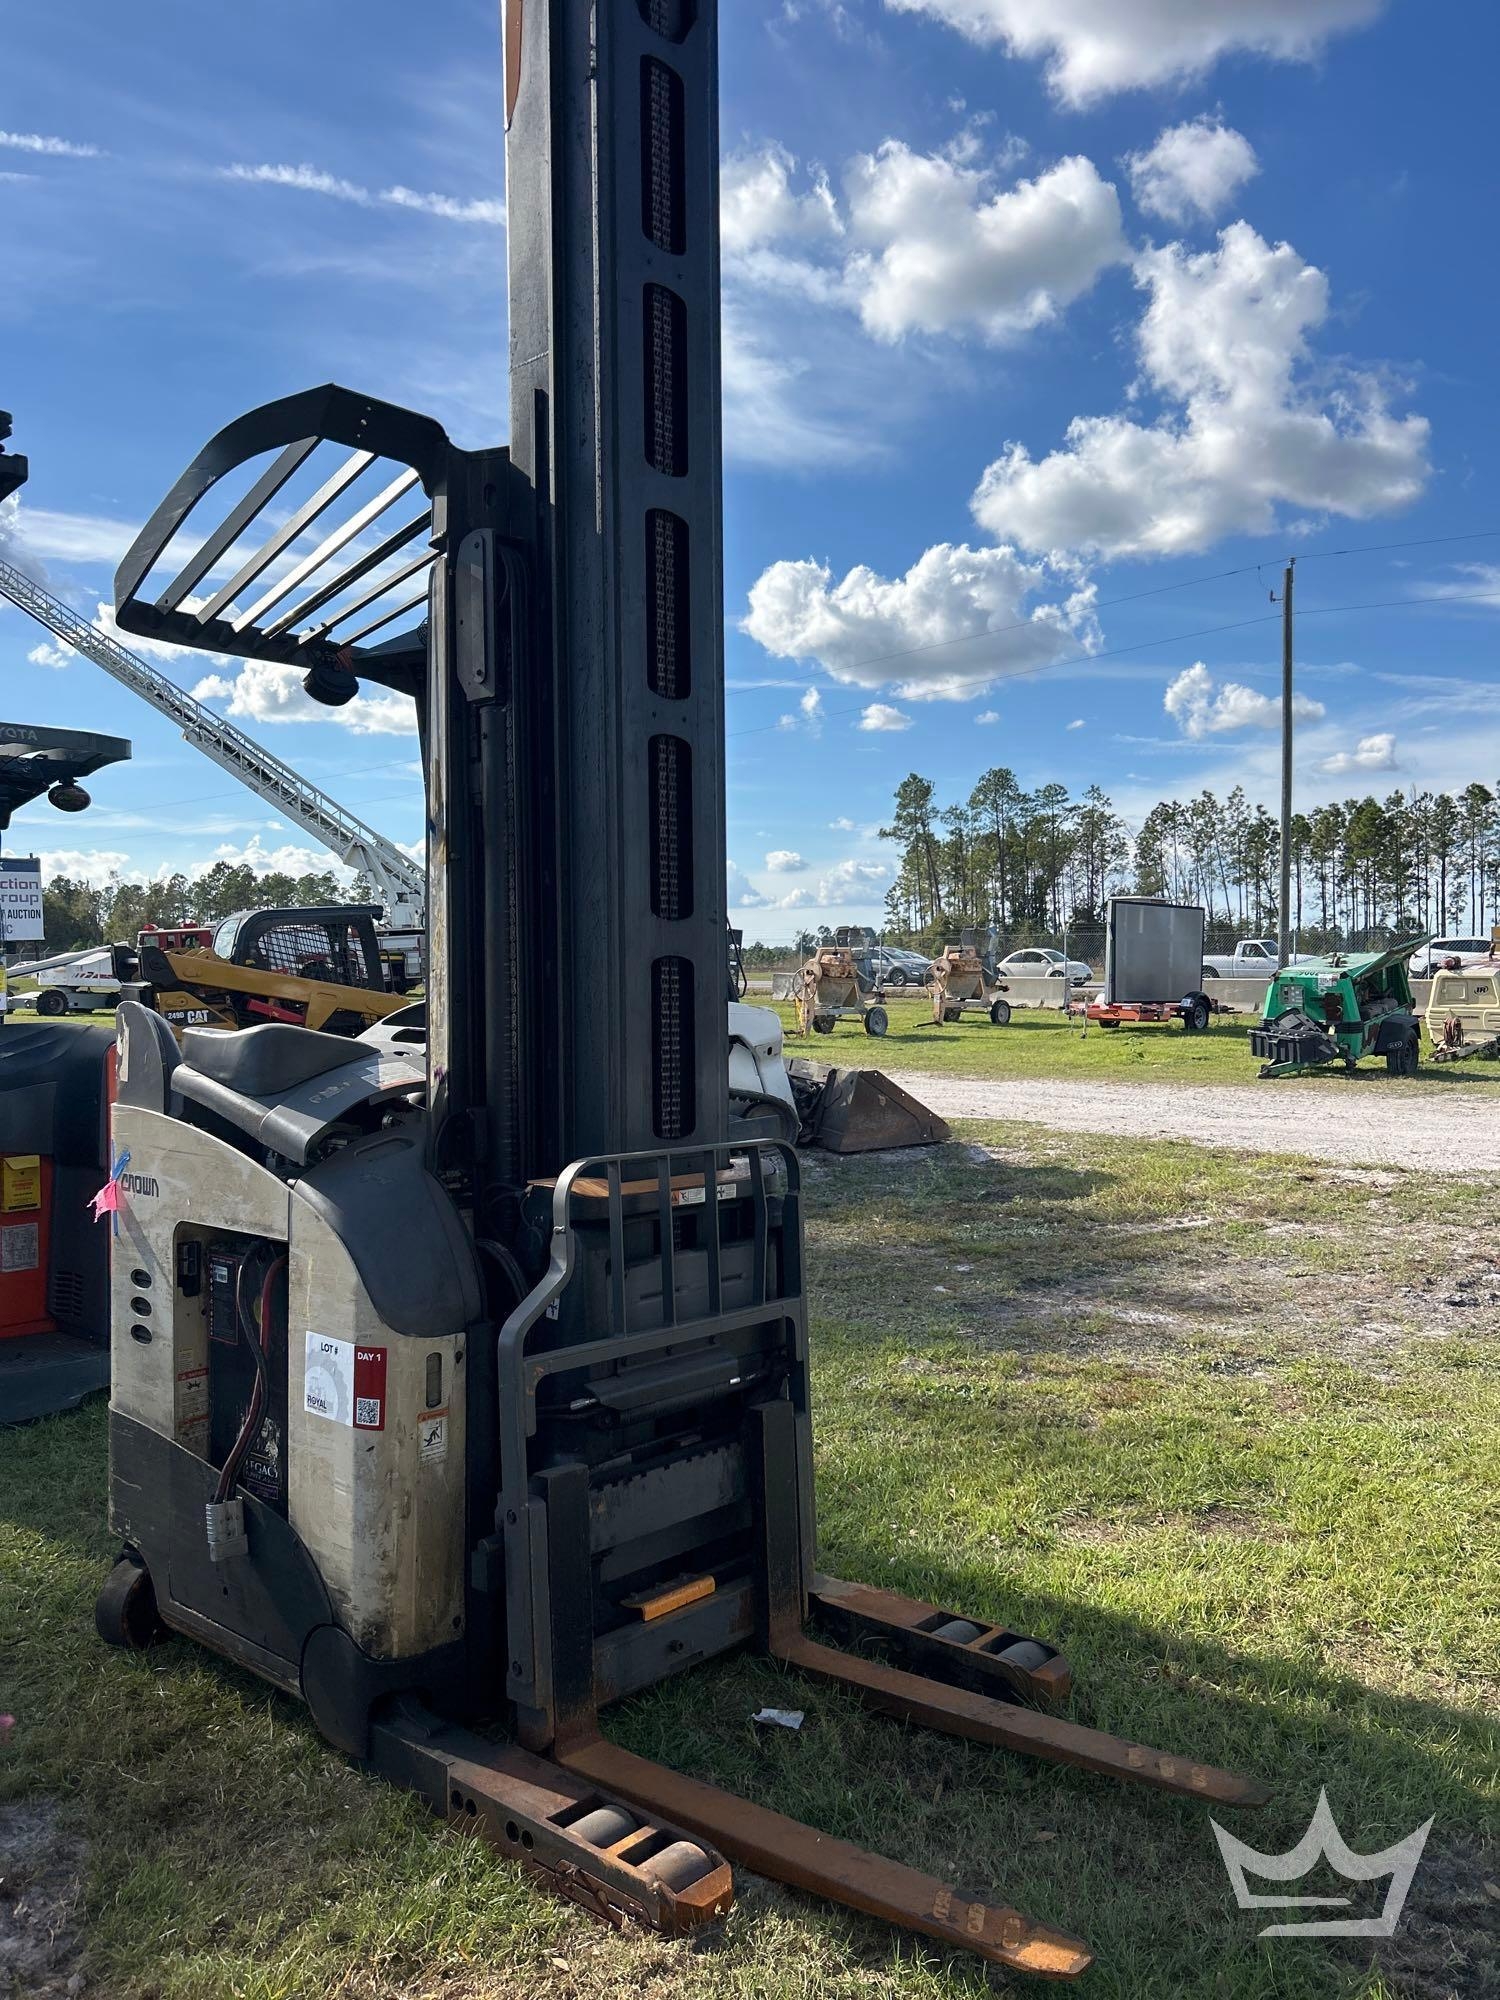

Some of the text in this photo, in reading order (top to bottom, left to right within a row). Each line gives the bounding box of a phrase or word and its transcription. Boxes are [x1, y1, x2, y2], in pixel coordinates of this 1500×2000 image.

[7, 909, 41, 919] AUCTION
[187, 1010, 209, 1024] CAT
[121, 1173, 159, 1197] CROWN
[320, 1342, 333, 1354] LOT
[357, 1352, 381, 1362] DAY 1
[307, 1395, 327, 1410] ROYAL
